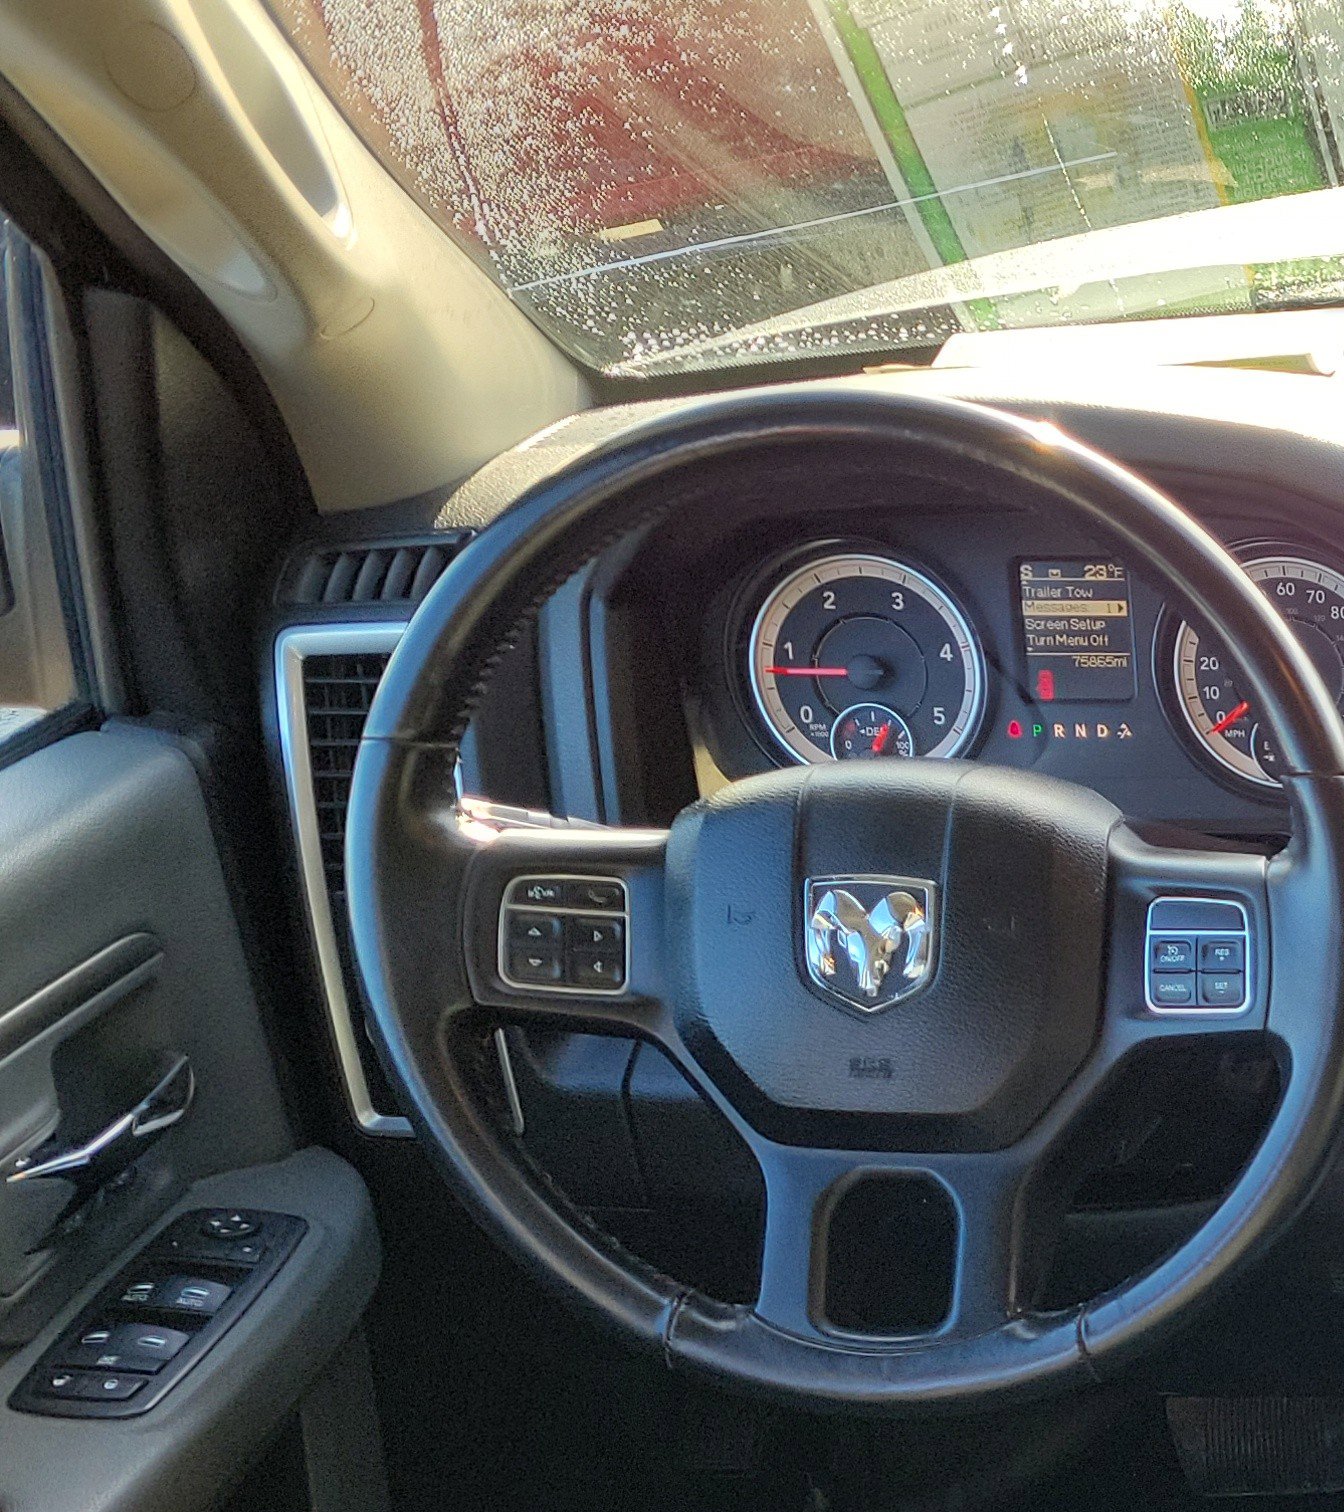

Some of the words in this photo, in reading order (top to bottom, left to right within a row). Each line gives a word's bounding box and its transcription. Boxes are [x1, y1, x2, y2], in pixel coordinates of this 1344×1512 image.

[1020, 565, 1032, 578] S
[1024, 586, 1062, 598] Trailer
[1066, 586, 1093, 598] Tow
[1276, 583, 1295, 596] 60
[822, 592, 836, 610] 2
[892, 592, 904, 610] 3
[1306, 590, 1325, 604] 70
[1024, 601, 1087, 615] Messages
[1025, 618, 1068, 630] Screen
[1070, 618, 1105, 631] Setup
[1027, 635, 1054, 646] Turn
[1055, 635, 1088, 647] Menu
[1090, 635, 1109, 646] Off
[784, 642, 793, 660] 1
[939, 643, 953, 661] 4
[1200, 657, 1219, 670] 20
[1203, 686, 1220, 700] 10
[800, 705, 813, 723] 0
[933, 708, 945, 725] 5
[1216, 711, 1226, 723] 0
[1032, 724, 1042, 737] P
[1054, 724, 1065, 738] R
[1075, 724, 1086, 738] N
[1097, 724, 1108, 738] D
[1225, 730, 1245, 738] MPH
[845, 740, 852, 749] 0
[1264, 742, 1269, 750] E
